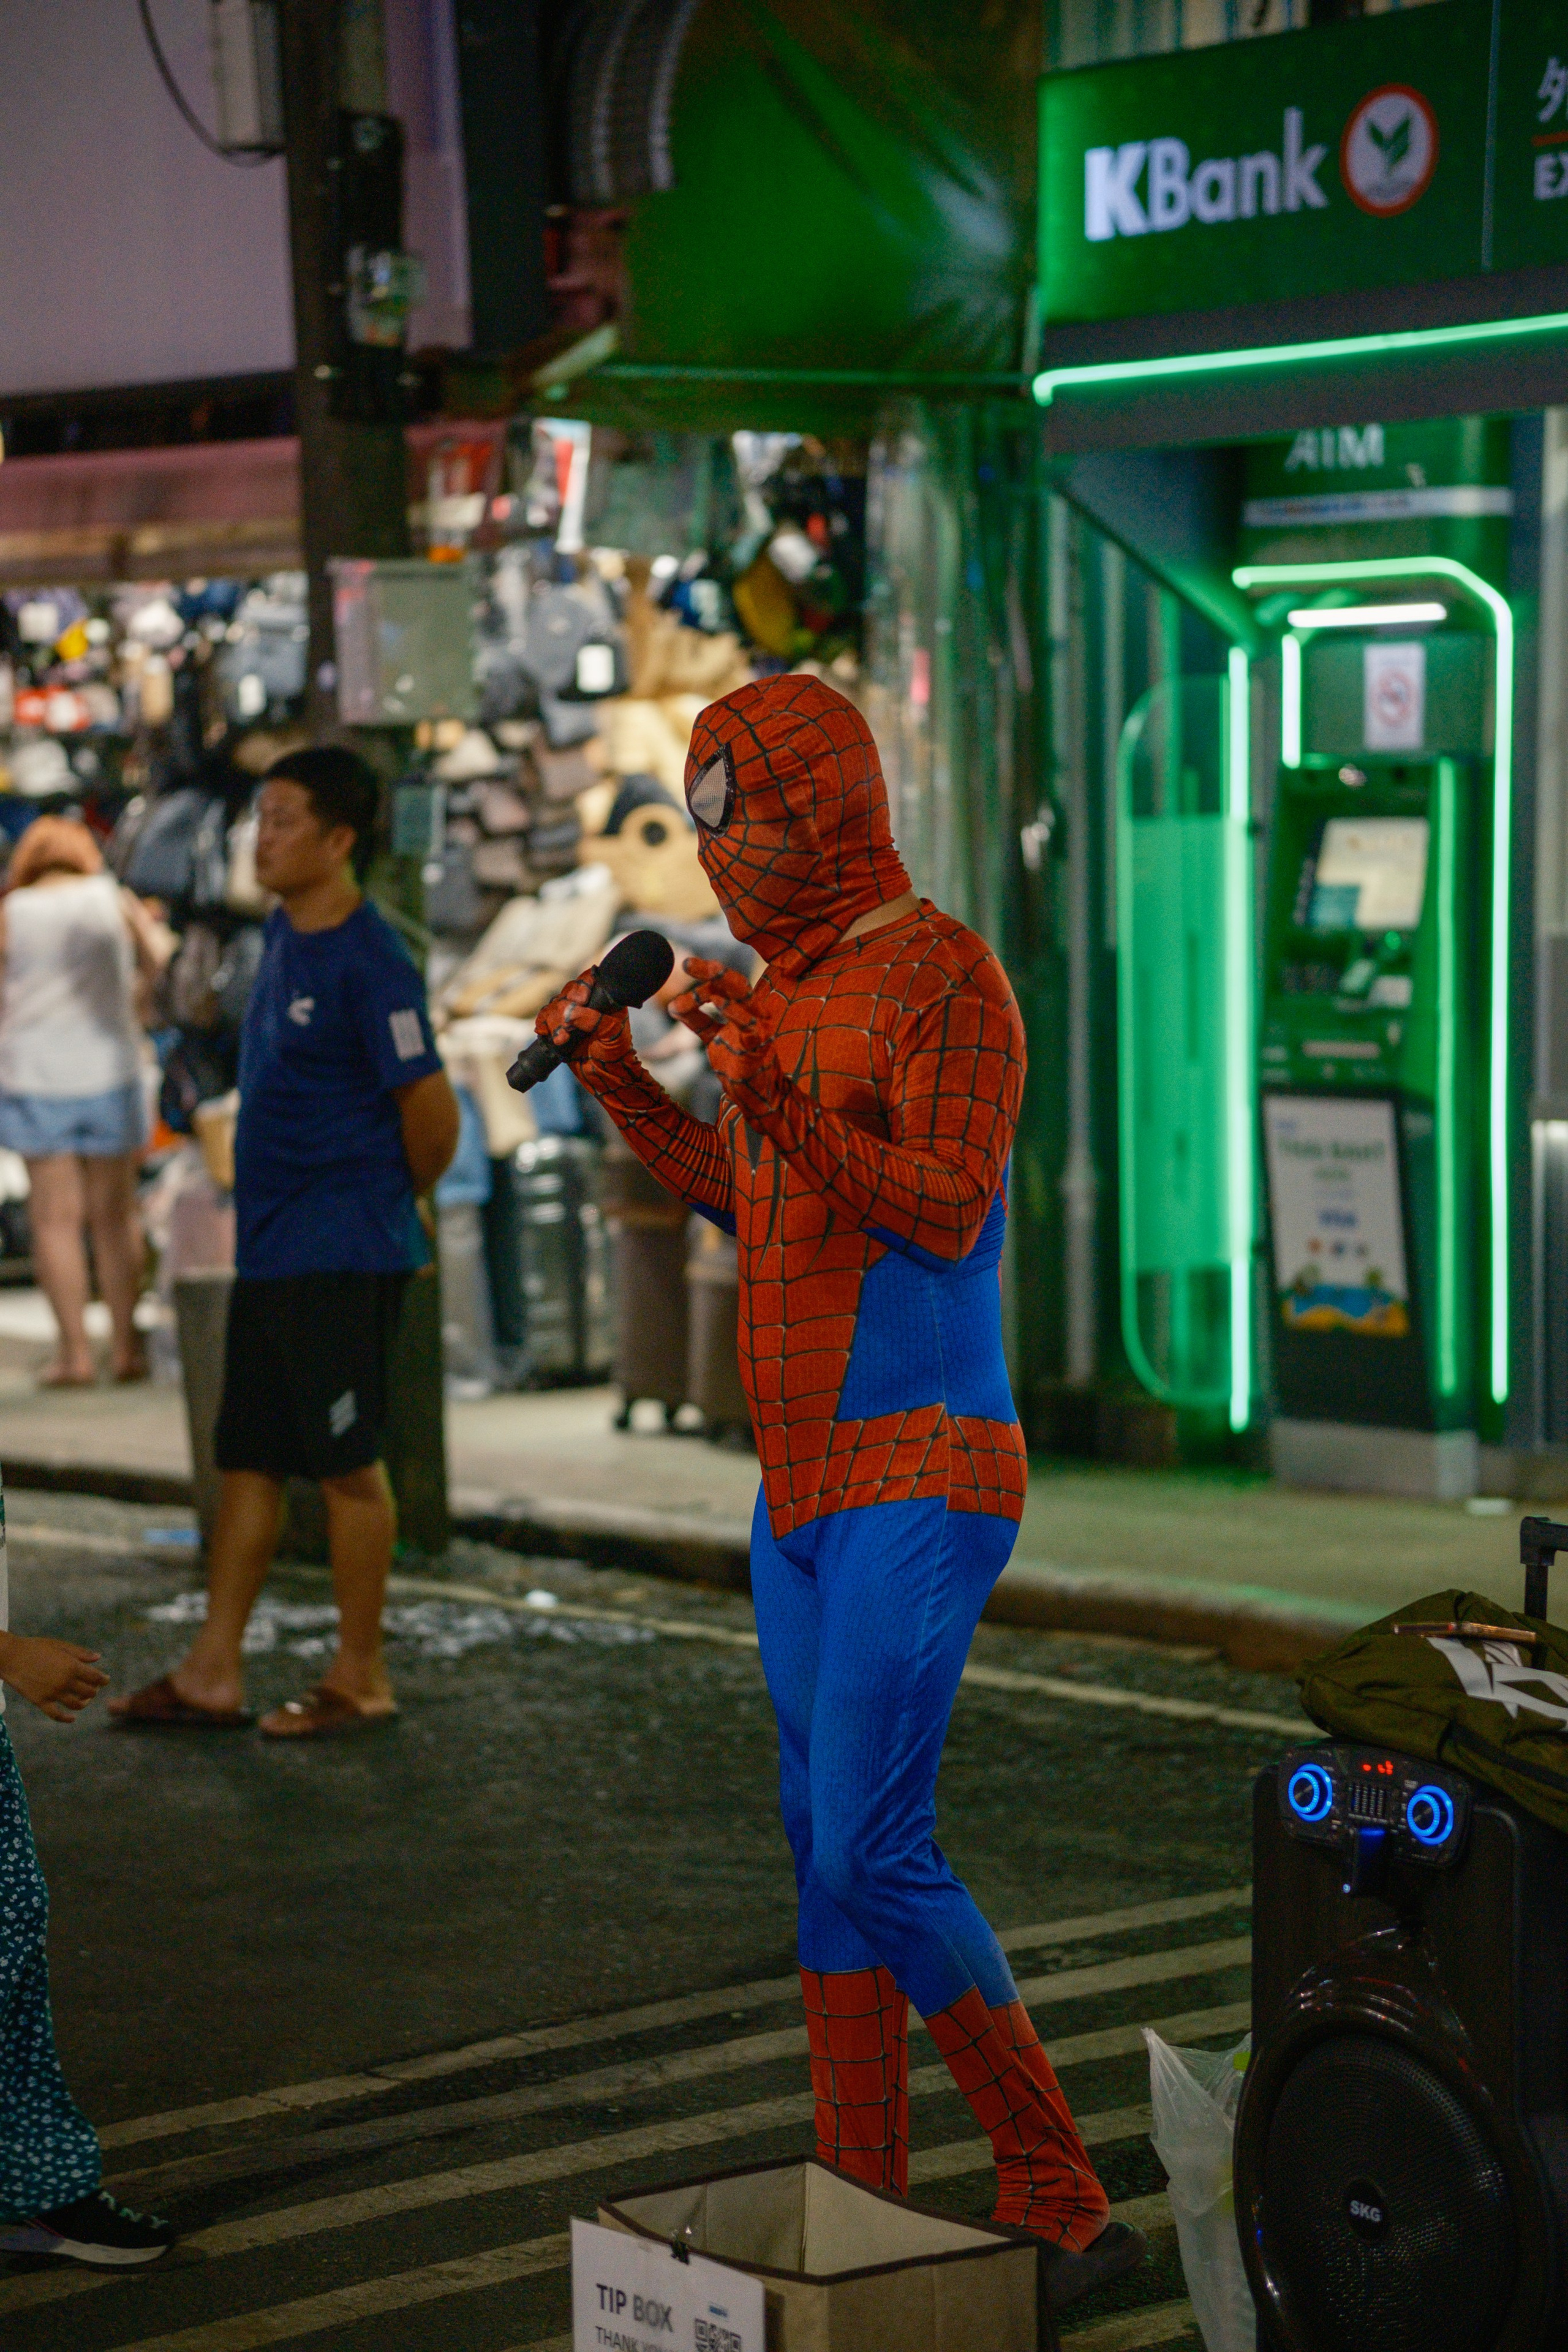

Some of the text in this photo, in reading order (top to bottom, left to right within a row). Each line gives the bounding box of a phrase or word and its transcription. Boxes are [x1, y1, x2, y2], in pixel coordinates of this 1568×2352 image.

[1084, 106, 1329, 241] KBank
[1350, 2200, 1381, 2222] SKG
[597, 2283, 627, 2315] TIP
[633, 2294, 673, 2332] BOX
